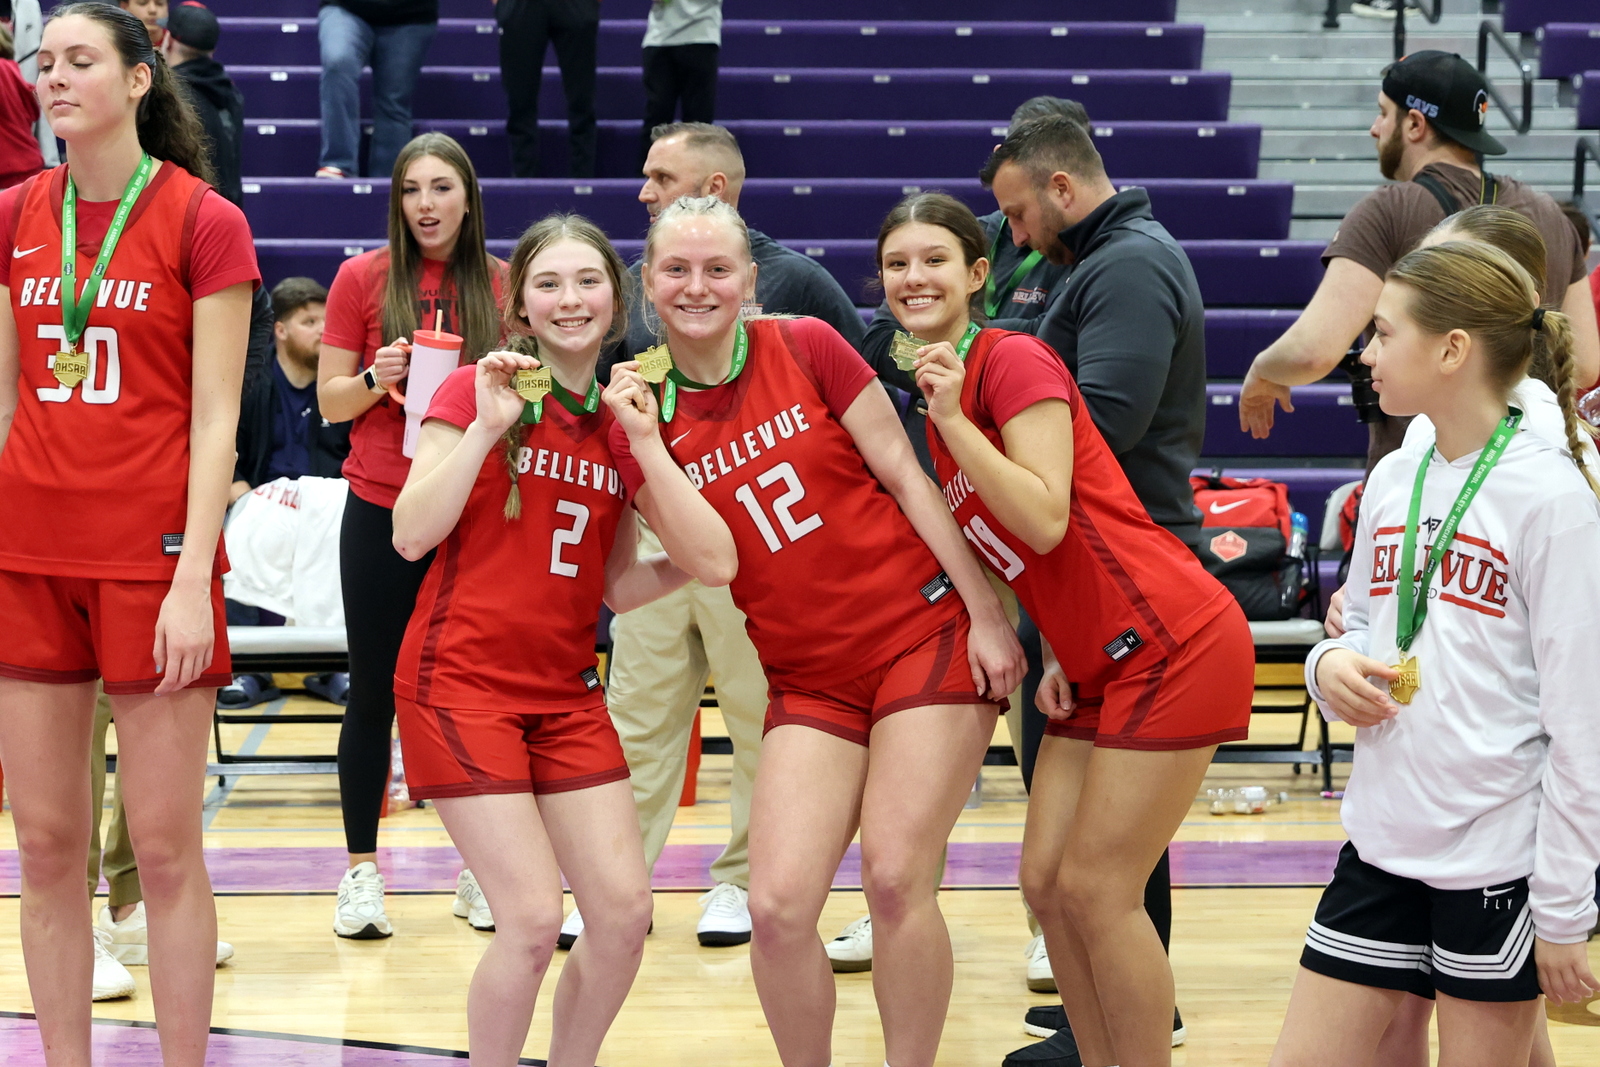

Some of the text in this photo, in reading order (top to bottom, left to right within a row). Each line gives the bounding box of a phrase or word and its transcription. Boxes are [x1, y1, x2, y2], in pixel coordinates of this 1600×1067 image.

[1405, 94, 1439, 118] CAVS
[125, 187, 138, 204] SCHOOL
[115, 205, 128, 226] ATHLETIC
[102, 228, 119, 257] ASSOCIATION
[20, 277, 152, 311] BELVUE
[36, 324, 121, 404] 30
[55, 362, 87, 376] OHSAA
[518, 378, 551, 391] OHSAA
[684, 403, 811, 491] BELLEVUE
[1436, 433, 1507, 552] OHIO HIGH SCHOOL ATHLETIC ASSOCIATION
[734, 461, 824, 554] 12
[549, 498, 590, 578] 2
[1126, 634, 1137, 646] M
[1483, 897, 1513, 910] FLY
